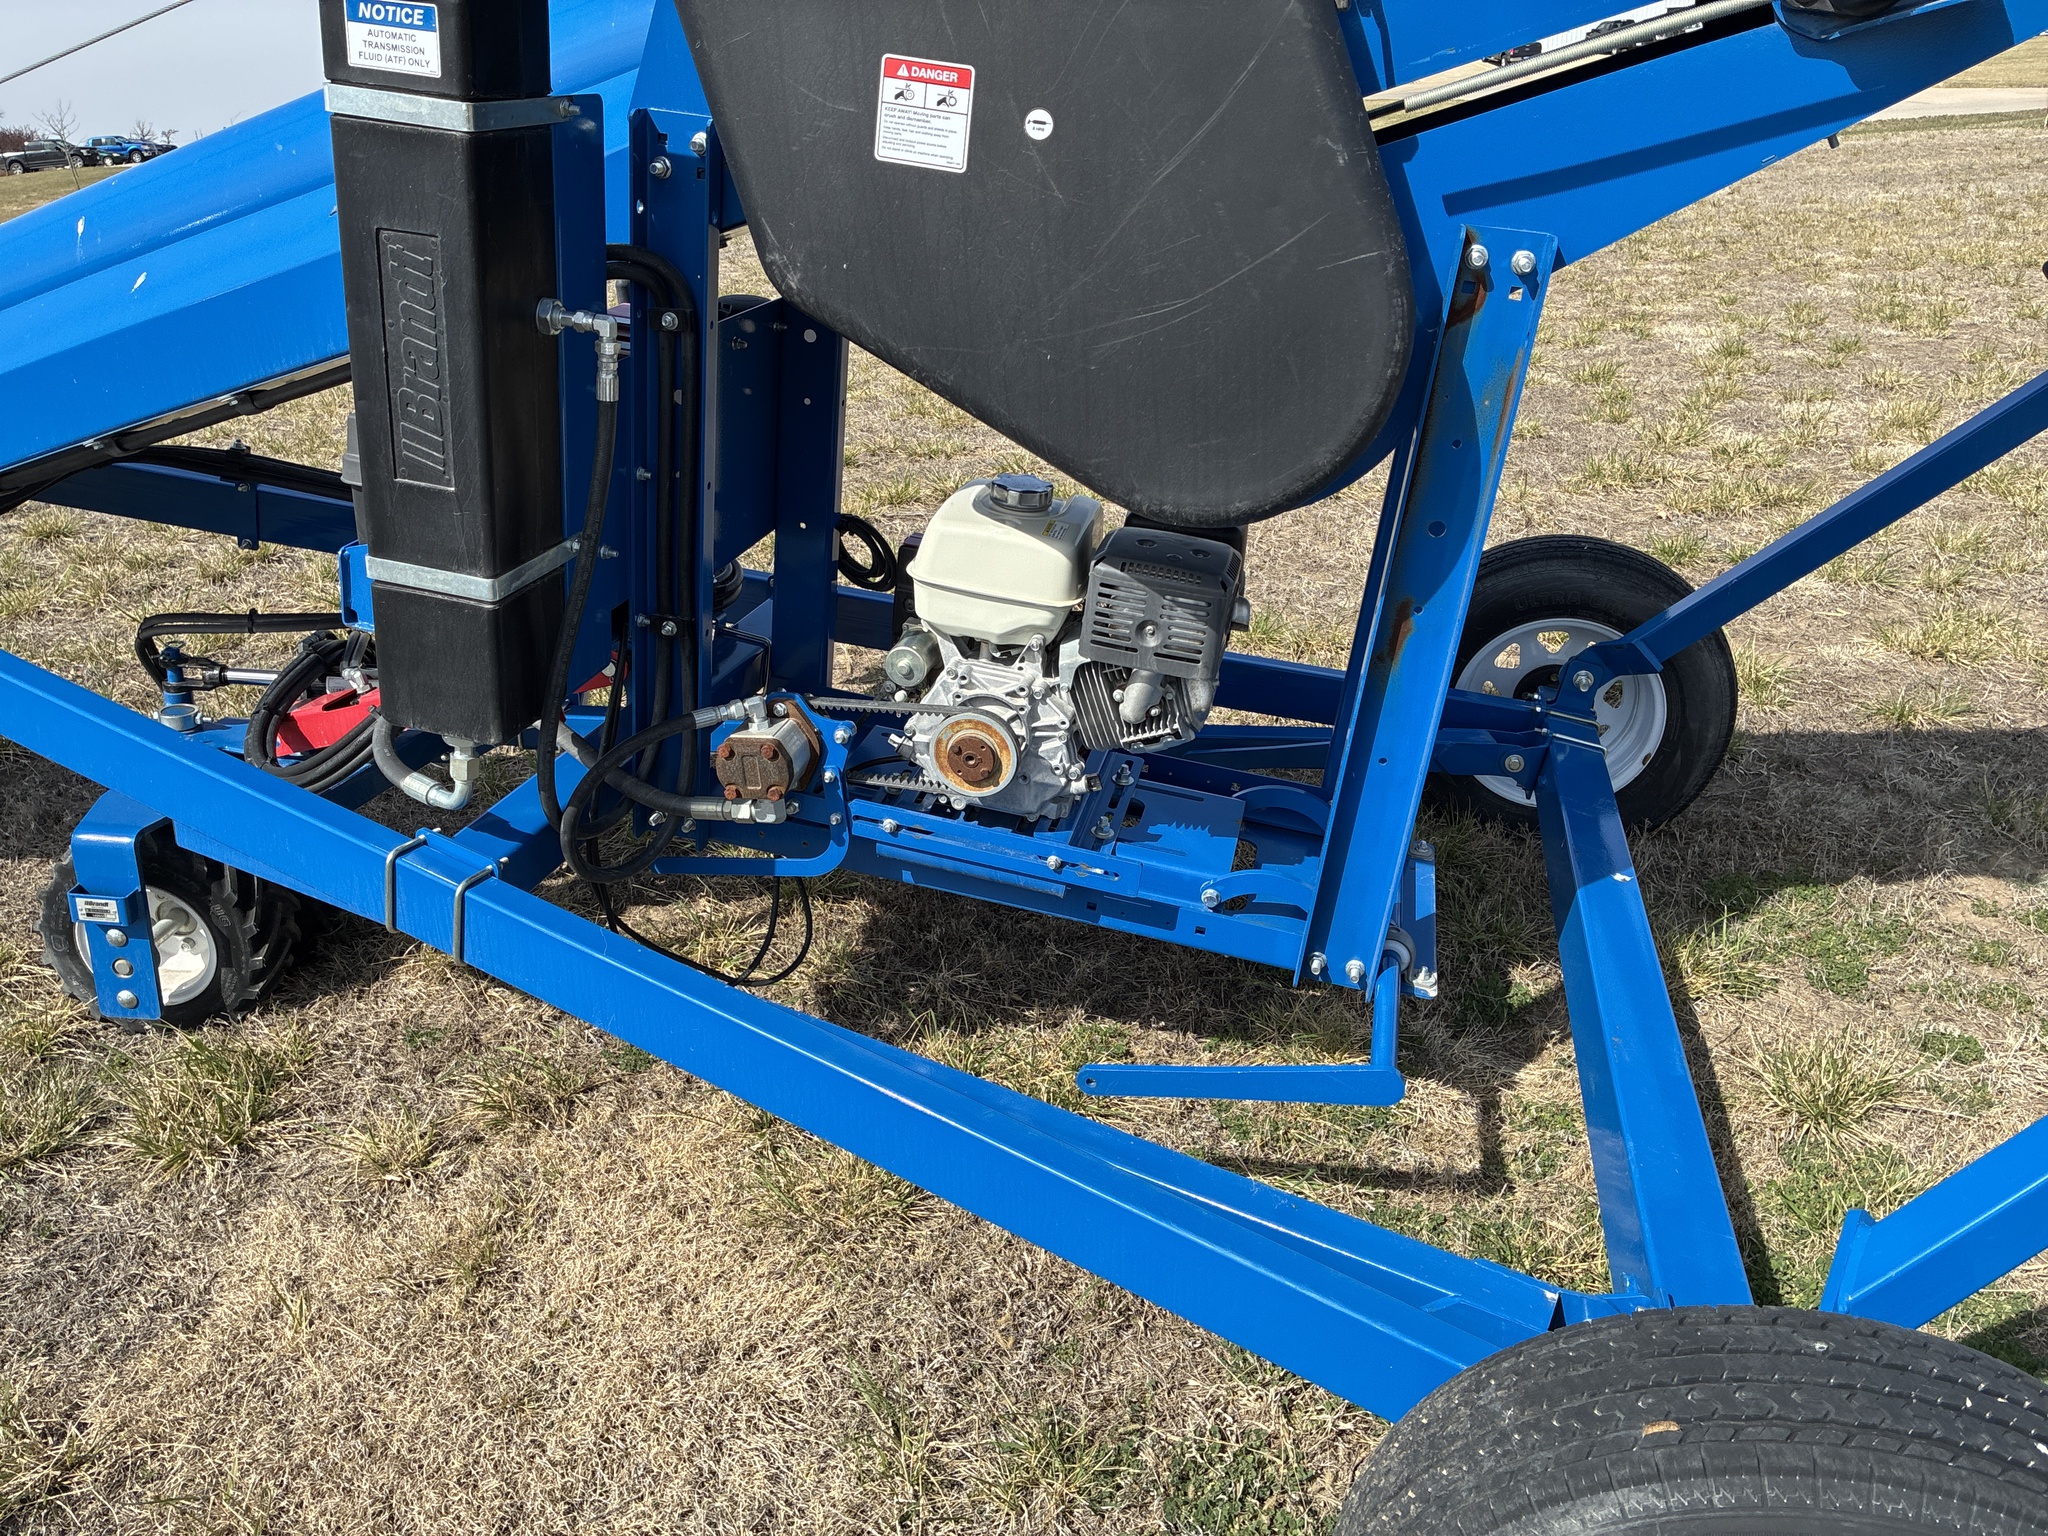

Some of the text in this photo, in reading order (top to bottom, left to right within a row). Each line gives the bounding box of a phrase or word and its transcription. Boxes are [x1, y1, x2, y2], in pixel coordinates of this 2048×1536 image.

[358, 2, 424, 26] NOTICE
[367, 29, 417, 43] AUTOMATIC
[362, 39, 425, 56] TRANSMISSION
[358, 50, 431, 68] FLUID (ATF) ONLY
[911, 66, 959, 83] DANGER
[913, 110, 929, 118] Moving
[388, 244, 445, 437] Brandt
[1514, 590, 1581, 610] ULTRA
